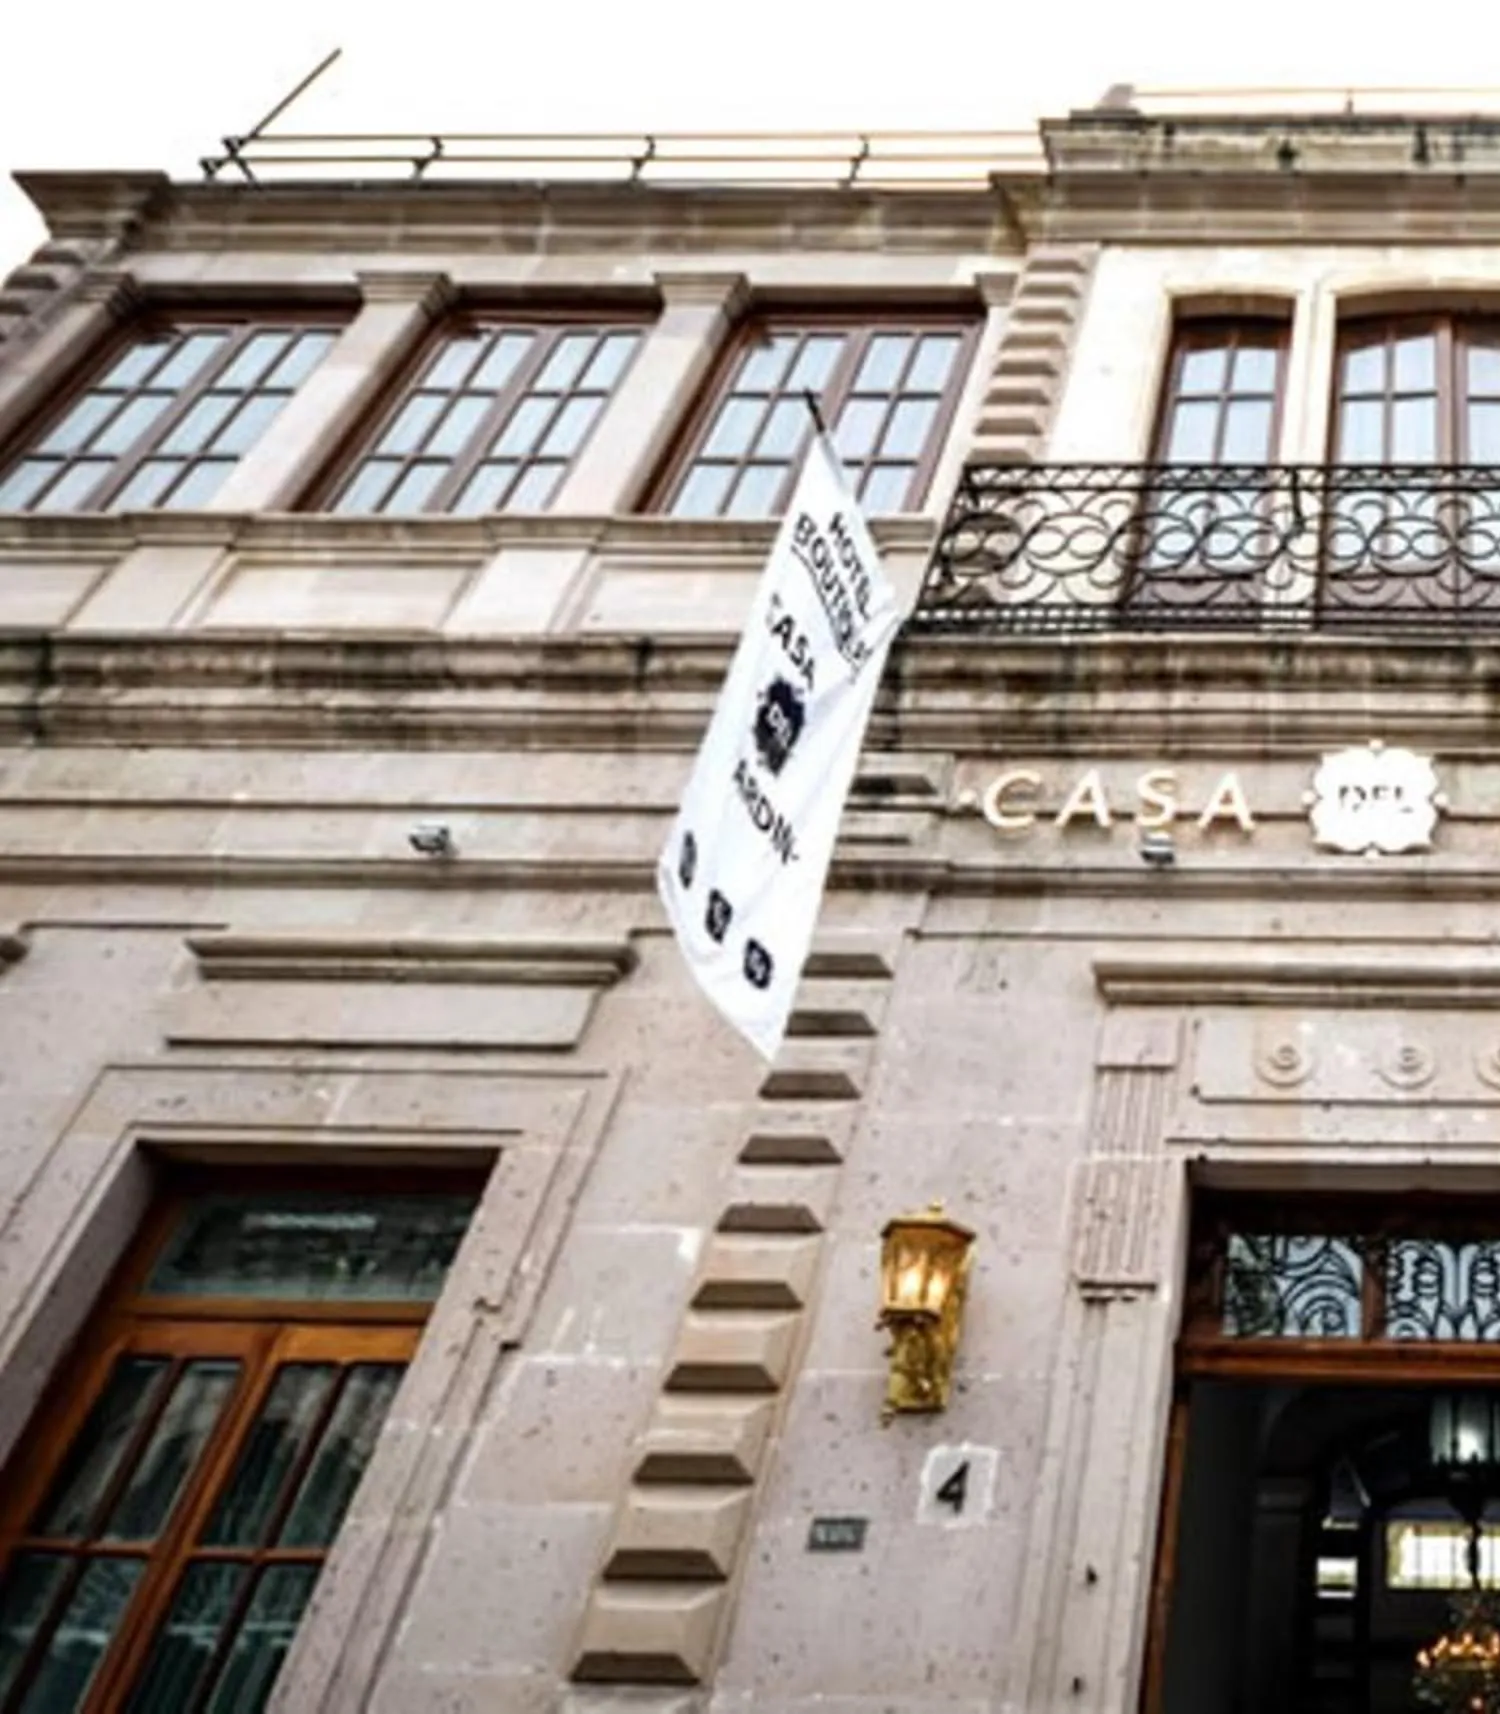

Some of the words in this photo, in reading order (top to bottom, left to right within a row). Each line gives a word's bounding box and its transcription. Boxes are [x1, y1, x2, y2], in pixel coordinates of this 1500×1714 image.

[829, 512, 871, 621] HOTEL
[982, 768, 1255, 831] CASA
[935, 1458, 971, 1514] 4
